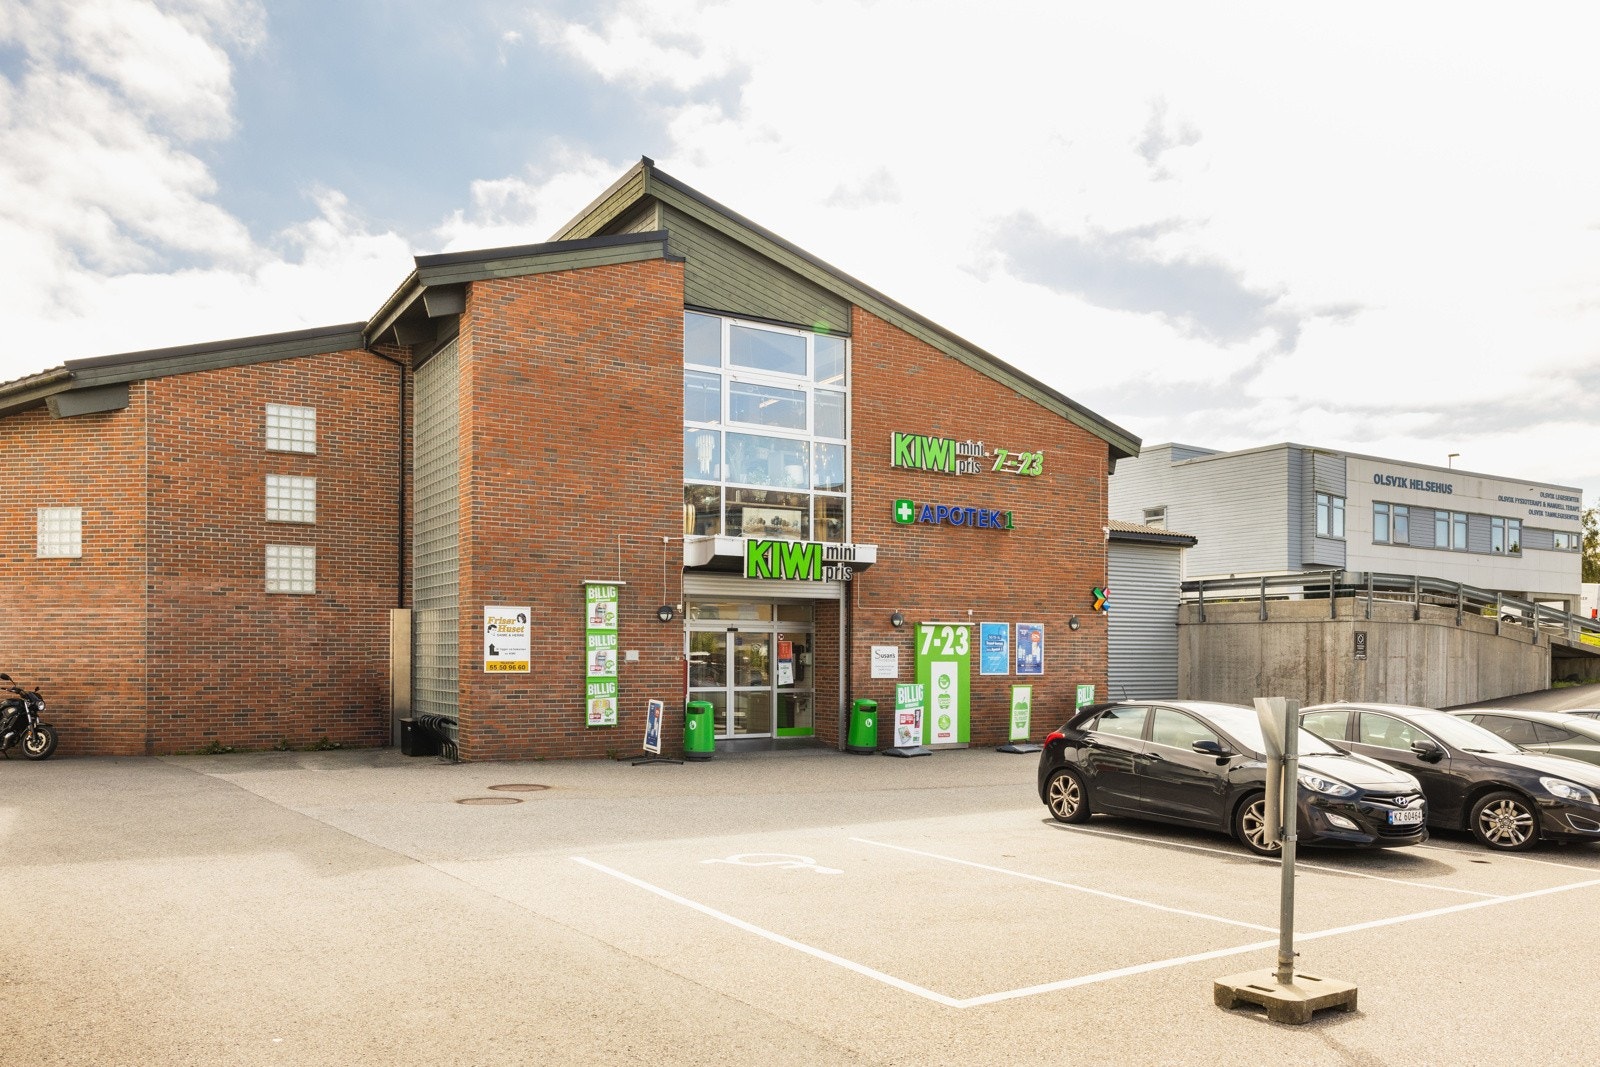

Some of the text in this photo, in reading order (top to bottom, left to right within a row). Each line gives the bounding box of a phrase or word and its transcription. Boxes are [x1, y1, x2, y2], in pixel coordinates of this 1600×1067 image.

[894, 432, 956, 473] KIWI
[959, 441, 984, 457] mini
[959, 458, 981, 475] pris
[995, 449, 1044, 476] 7-23
[1373, 473, 1453, 495] OLSVIK HELSEHUS
[1498, 494, 1514, 503] OLSVIK
[1565, 504, 1580, 512] TERAPI
[1540, 491, 1554, 499] OLSVIK
[920, 503, 1015, 530] APOTEK 1
[1528, 508, 1544, 517] OLSVIK
[747, 539, 823, 581] KIWI
[826, 543, 856, 561] mini
[825, 562, 853, 583] pris
[588, 586, 616, 599] BILLIG
[497, 624, 525, 633] Huset
[588, 634, 616, 647] BILLIG
[921, 626, 969, 656] 7-23
[588, 682, 616, 696] BILLIG
[897, 684, 924, 705] BILLIG
[1394, 811, 1421, 821] KZ 60464
